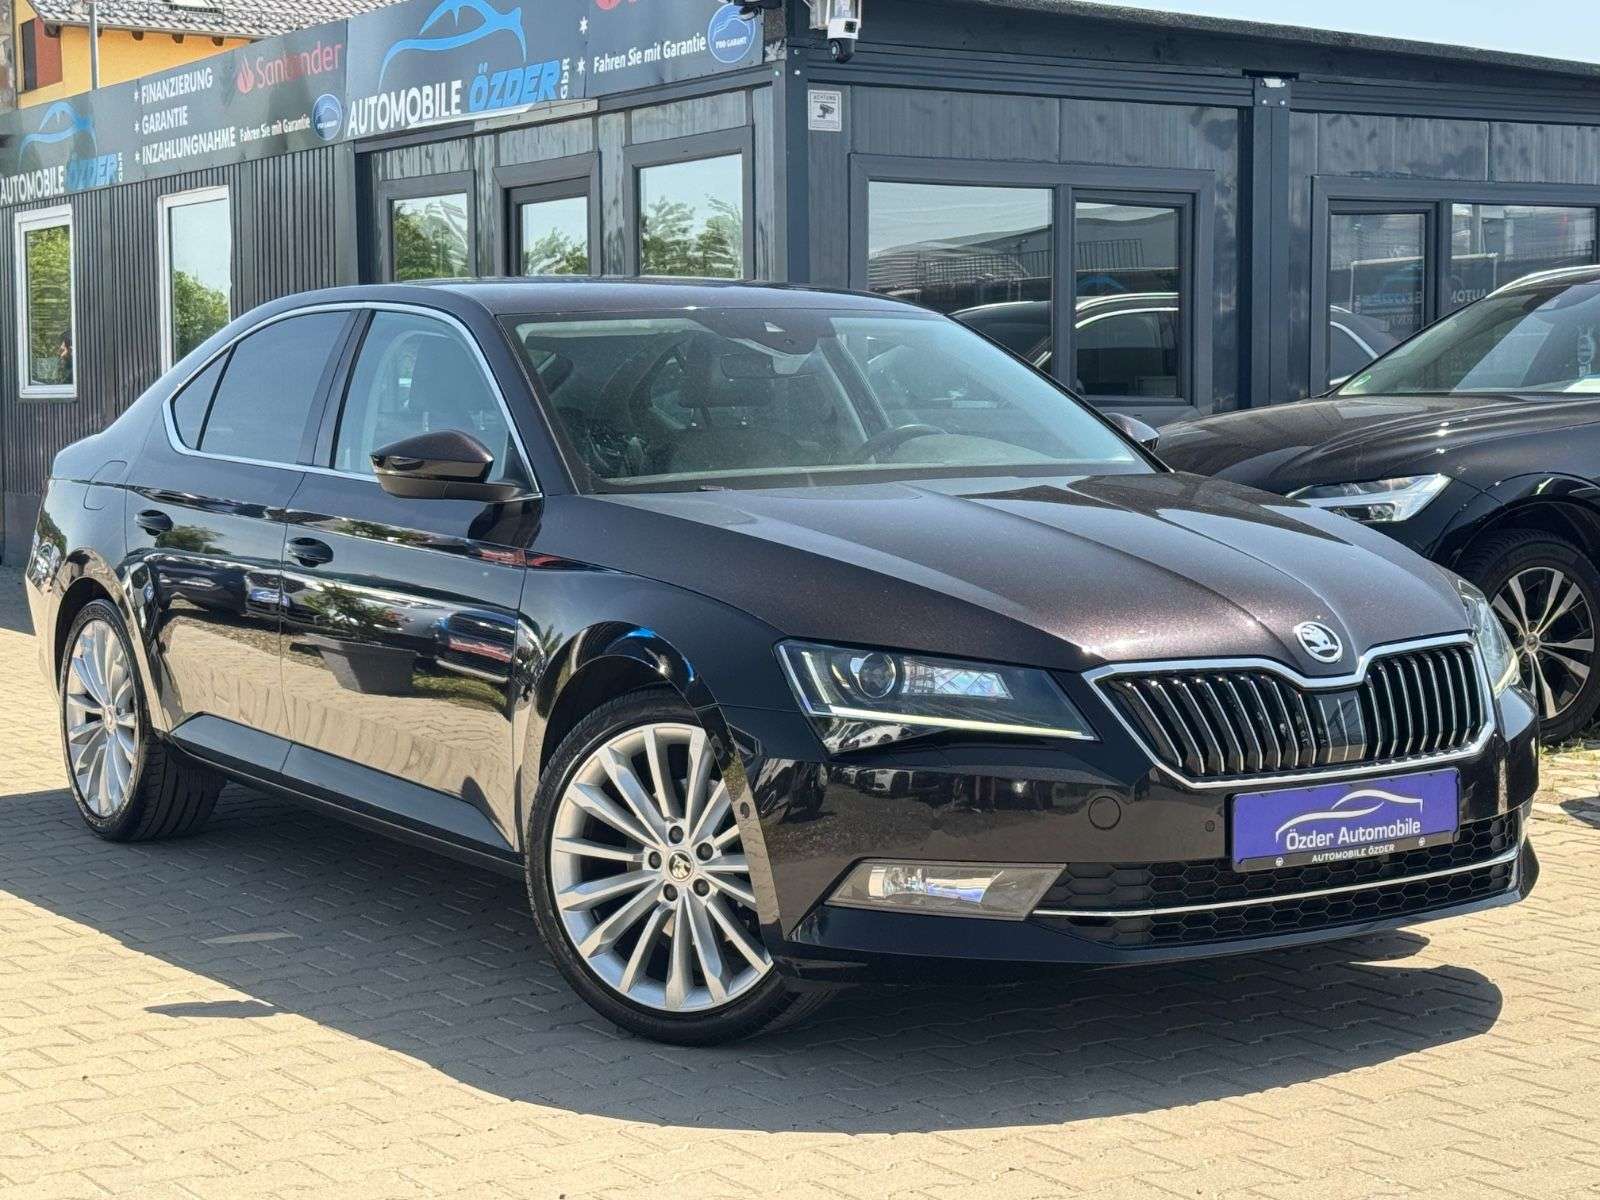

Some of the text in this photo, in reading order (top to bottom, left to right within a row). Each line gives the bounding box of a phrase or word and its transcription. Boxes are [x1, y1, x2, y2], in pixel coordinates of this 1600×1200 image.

[593, 32, 706, 74] Fahren Sie mit Garantie
[141, 67, 213, 105] FINANZIERUNG
[347, 60, 560, 137] AUTOMOBILE ÖZDER
[141, 105, 189, 135] GARANTIE
[239, 126, 261, 143] Fahren
[261, 123, 271, 138] Sie
[283, 113, 311, 133] Garantie
[142, 126, 235, 165] INZAHLUNGNAHME
[0, 165, 65, 206] AUTOMOBILE
[1286, 818, 1421, 851] Özder Automobile
[1311, 843, 1395, 864] AUTOMOBILE ÖZDER
